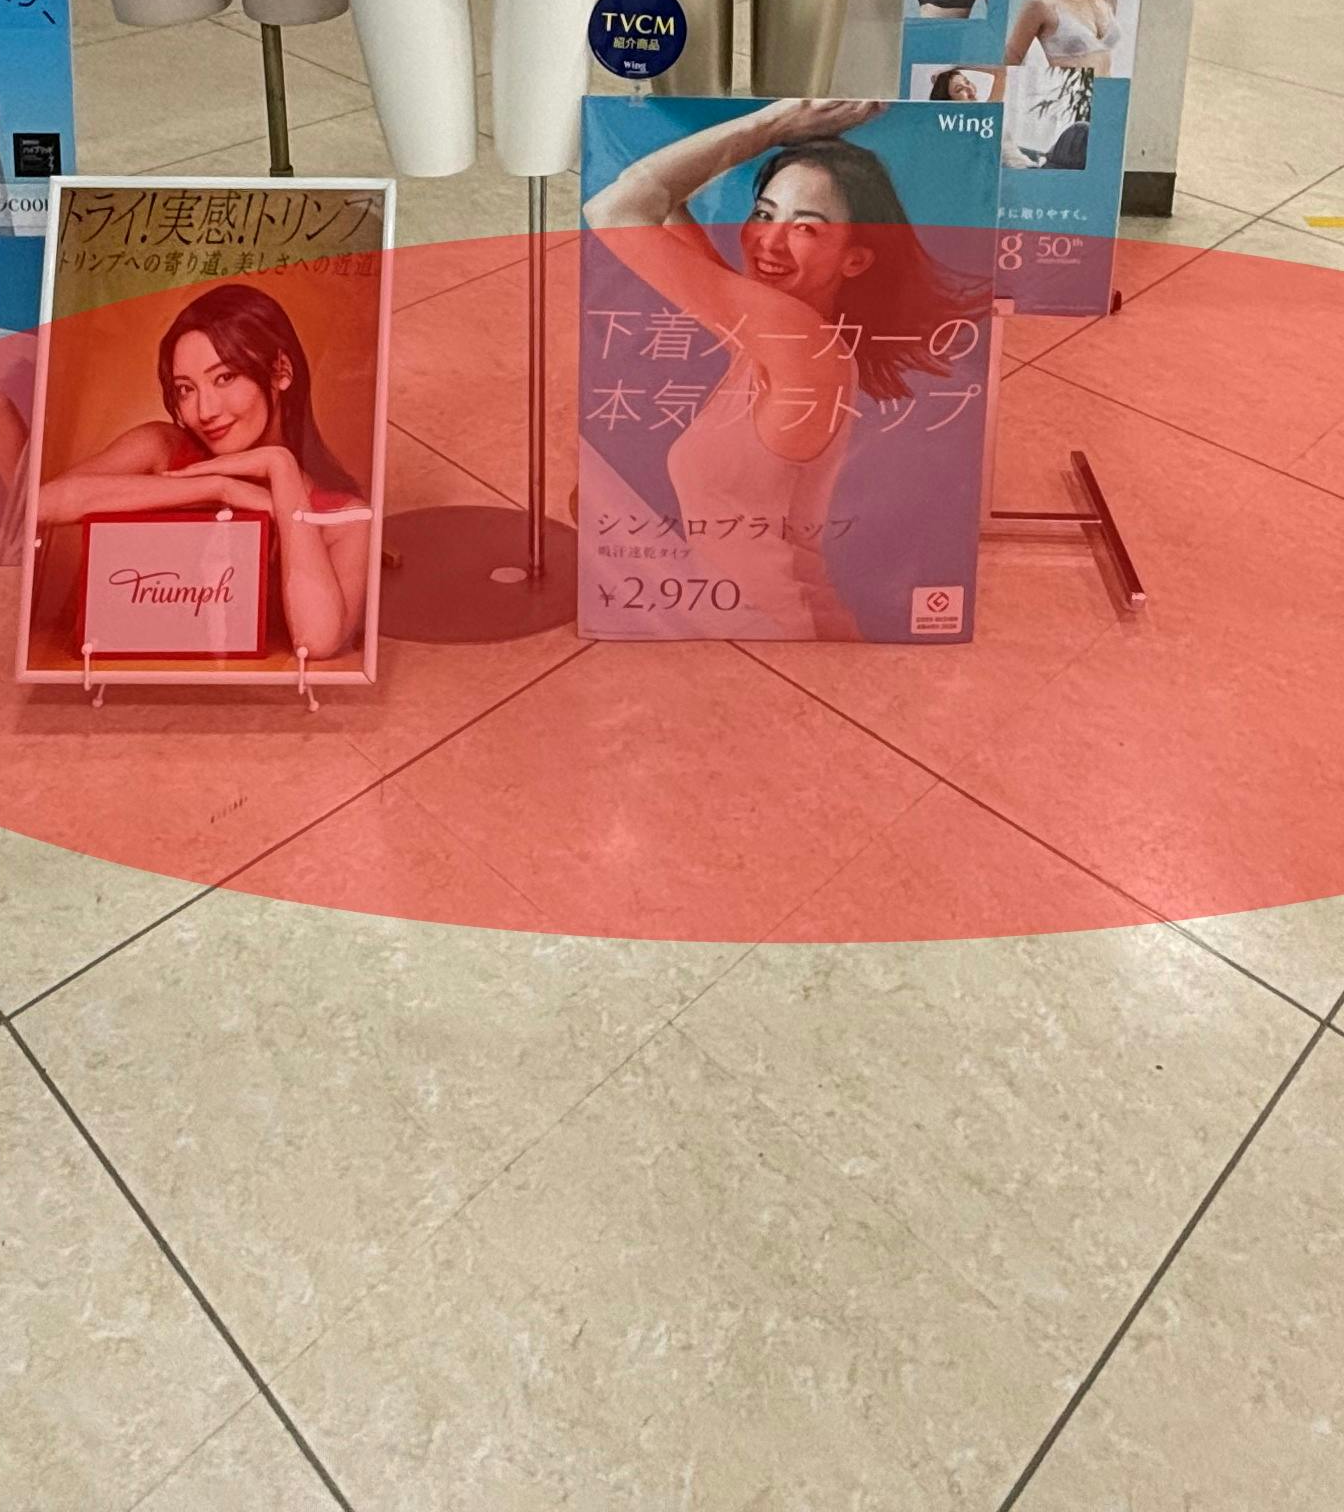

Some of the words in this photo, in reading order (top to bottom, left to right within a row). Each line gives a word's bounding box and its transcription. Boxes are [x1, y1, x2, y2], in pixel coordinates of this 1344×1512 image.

[601, 12, 675, 36] TVCM
[937, 113, 994, 139] Wing
[586, 308, 980, 362] 下着メーカーの
[585, 377, 982, 433] 本気ブラトップ
[596, 512, 860, 541] シンクロブラトップ
[109, 567, 234, 617] Triumph
[597, 575, 741, 613] ¥2,970
